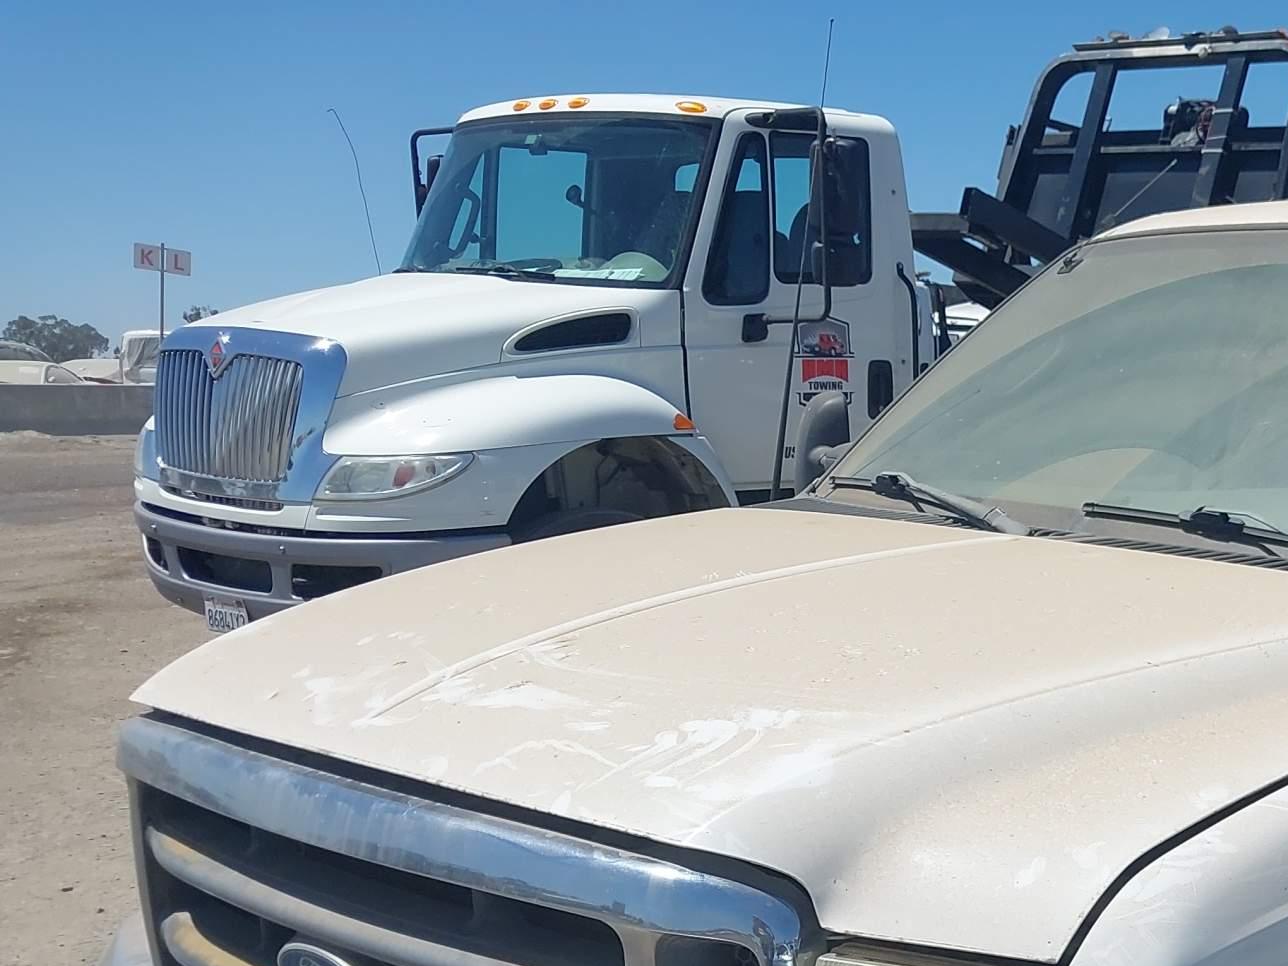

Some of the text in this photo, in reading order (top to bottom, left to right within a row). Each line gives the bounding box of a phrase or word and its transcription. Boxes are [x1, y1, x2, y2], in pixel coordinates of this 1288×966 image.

[141, 248, 154, 266] K
[174, 254, 185, 271] L
[808, 381, 843, 391] TOWING
